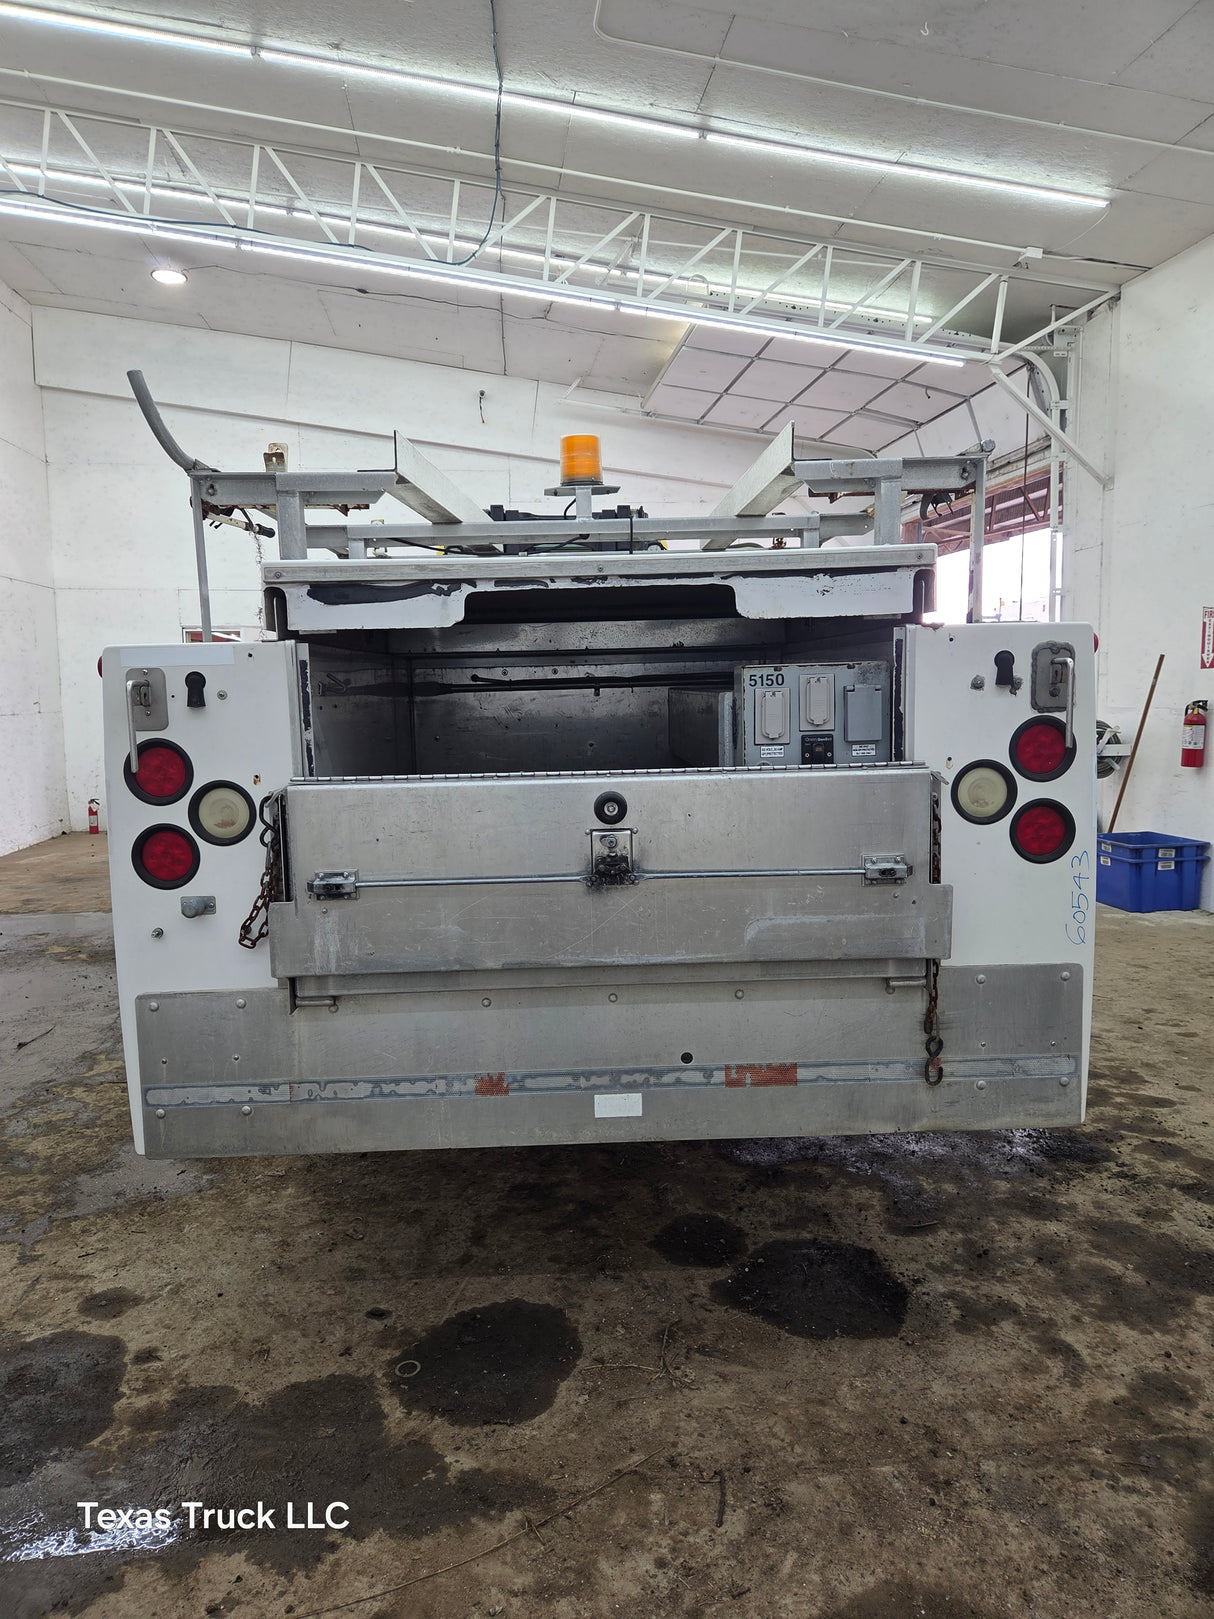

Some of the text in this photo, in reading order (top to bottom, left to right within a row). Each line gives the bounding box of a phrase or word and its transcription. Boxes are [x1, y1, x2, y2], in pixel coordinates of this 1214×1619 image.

[1204, 610, 1214, 618] FIR
[749, 673, 785, 687] 5150
[1065, 850, 1089, 945] 60543
